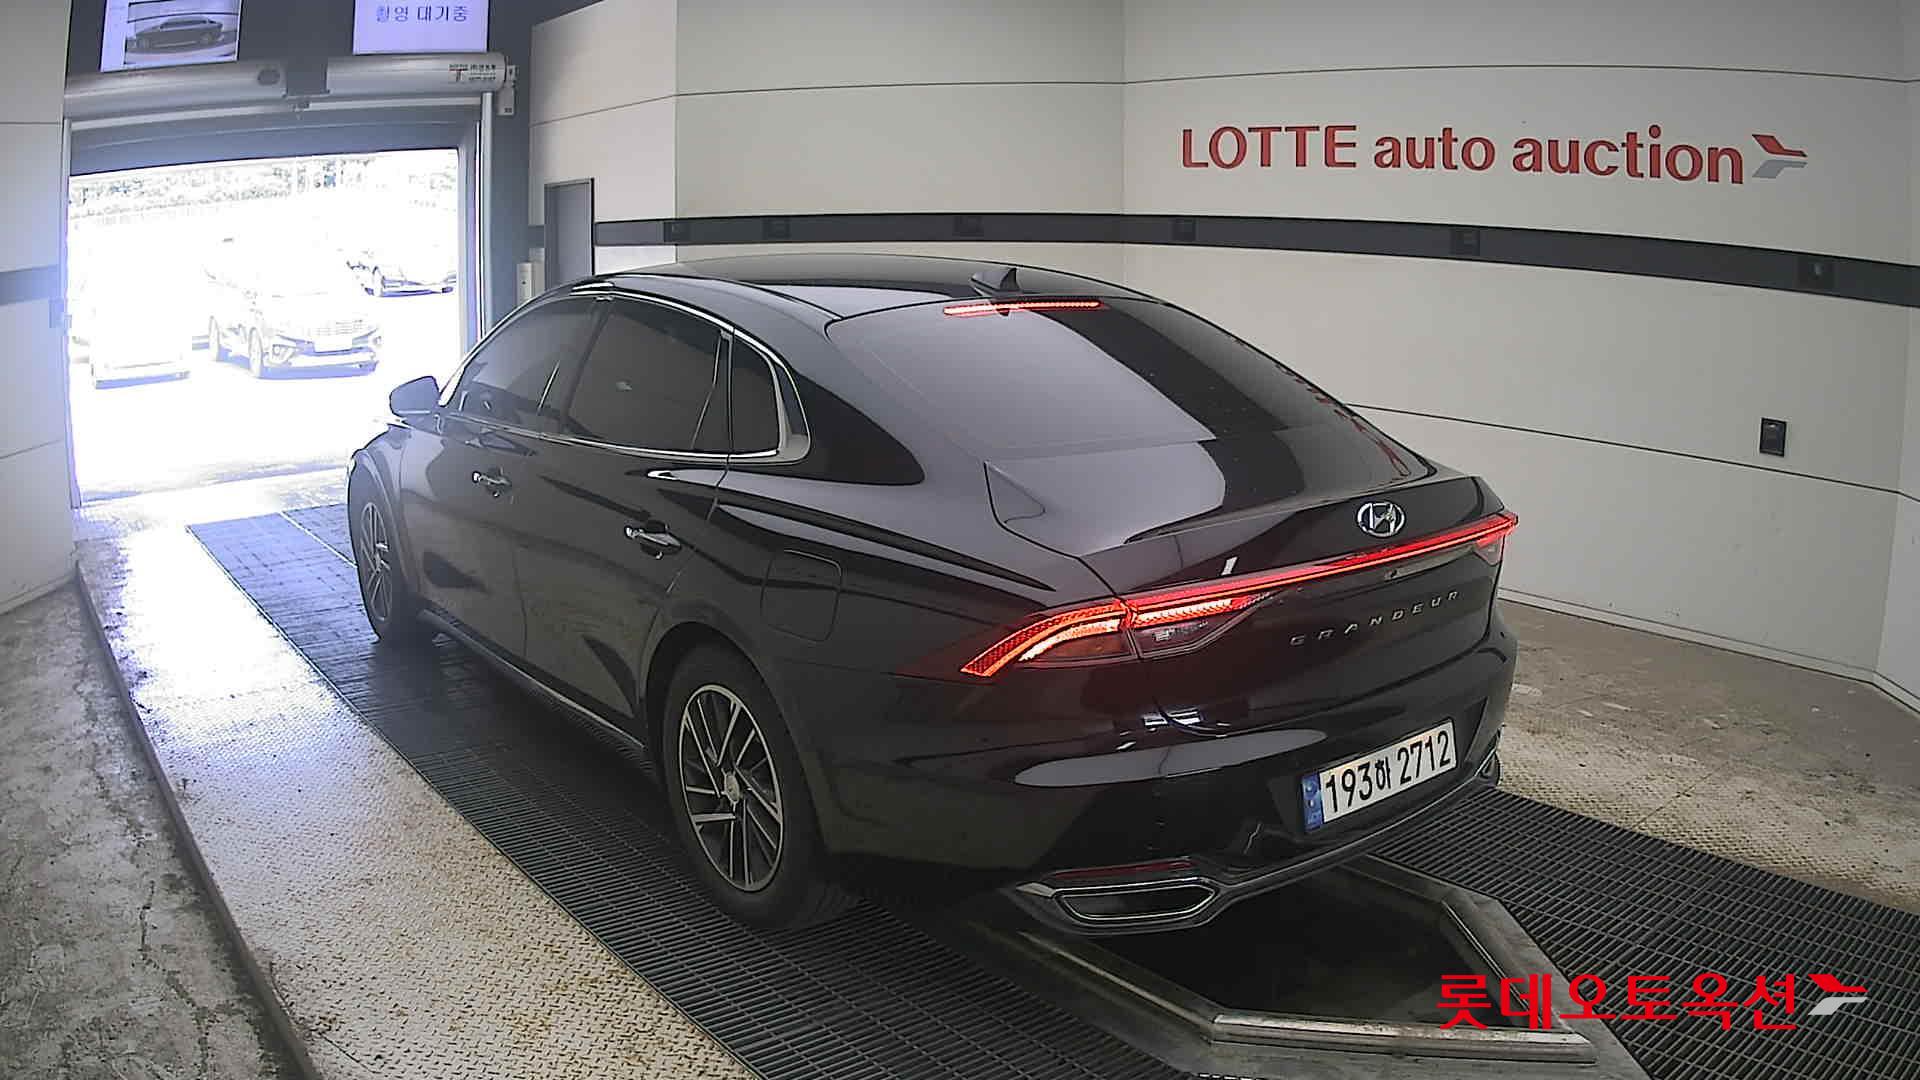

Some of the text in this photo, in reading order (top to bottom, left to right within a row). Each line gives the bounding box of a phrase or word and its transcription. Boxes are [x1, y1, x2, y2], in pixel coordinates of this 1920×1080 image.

[417, 6, 466, 22] 대기중
[1182, 124, 1743, 184] LOTTE auto auction
[1290, 591, 1459, 646] GRANDEUR
[1326, 730, 1451, 812] 193하 2712
